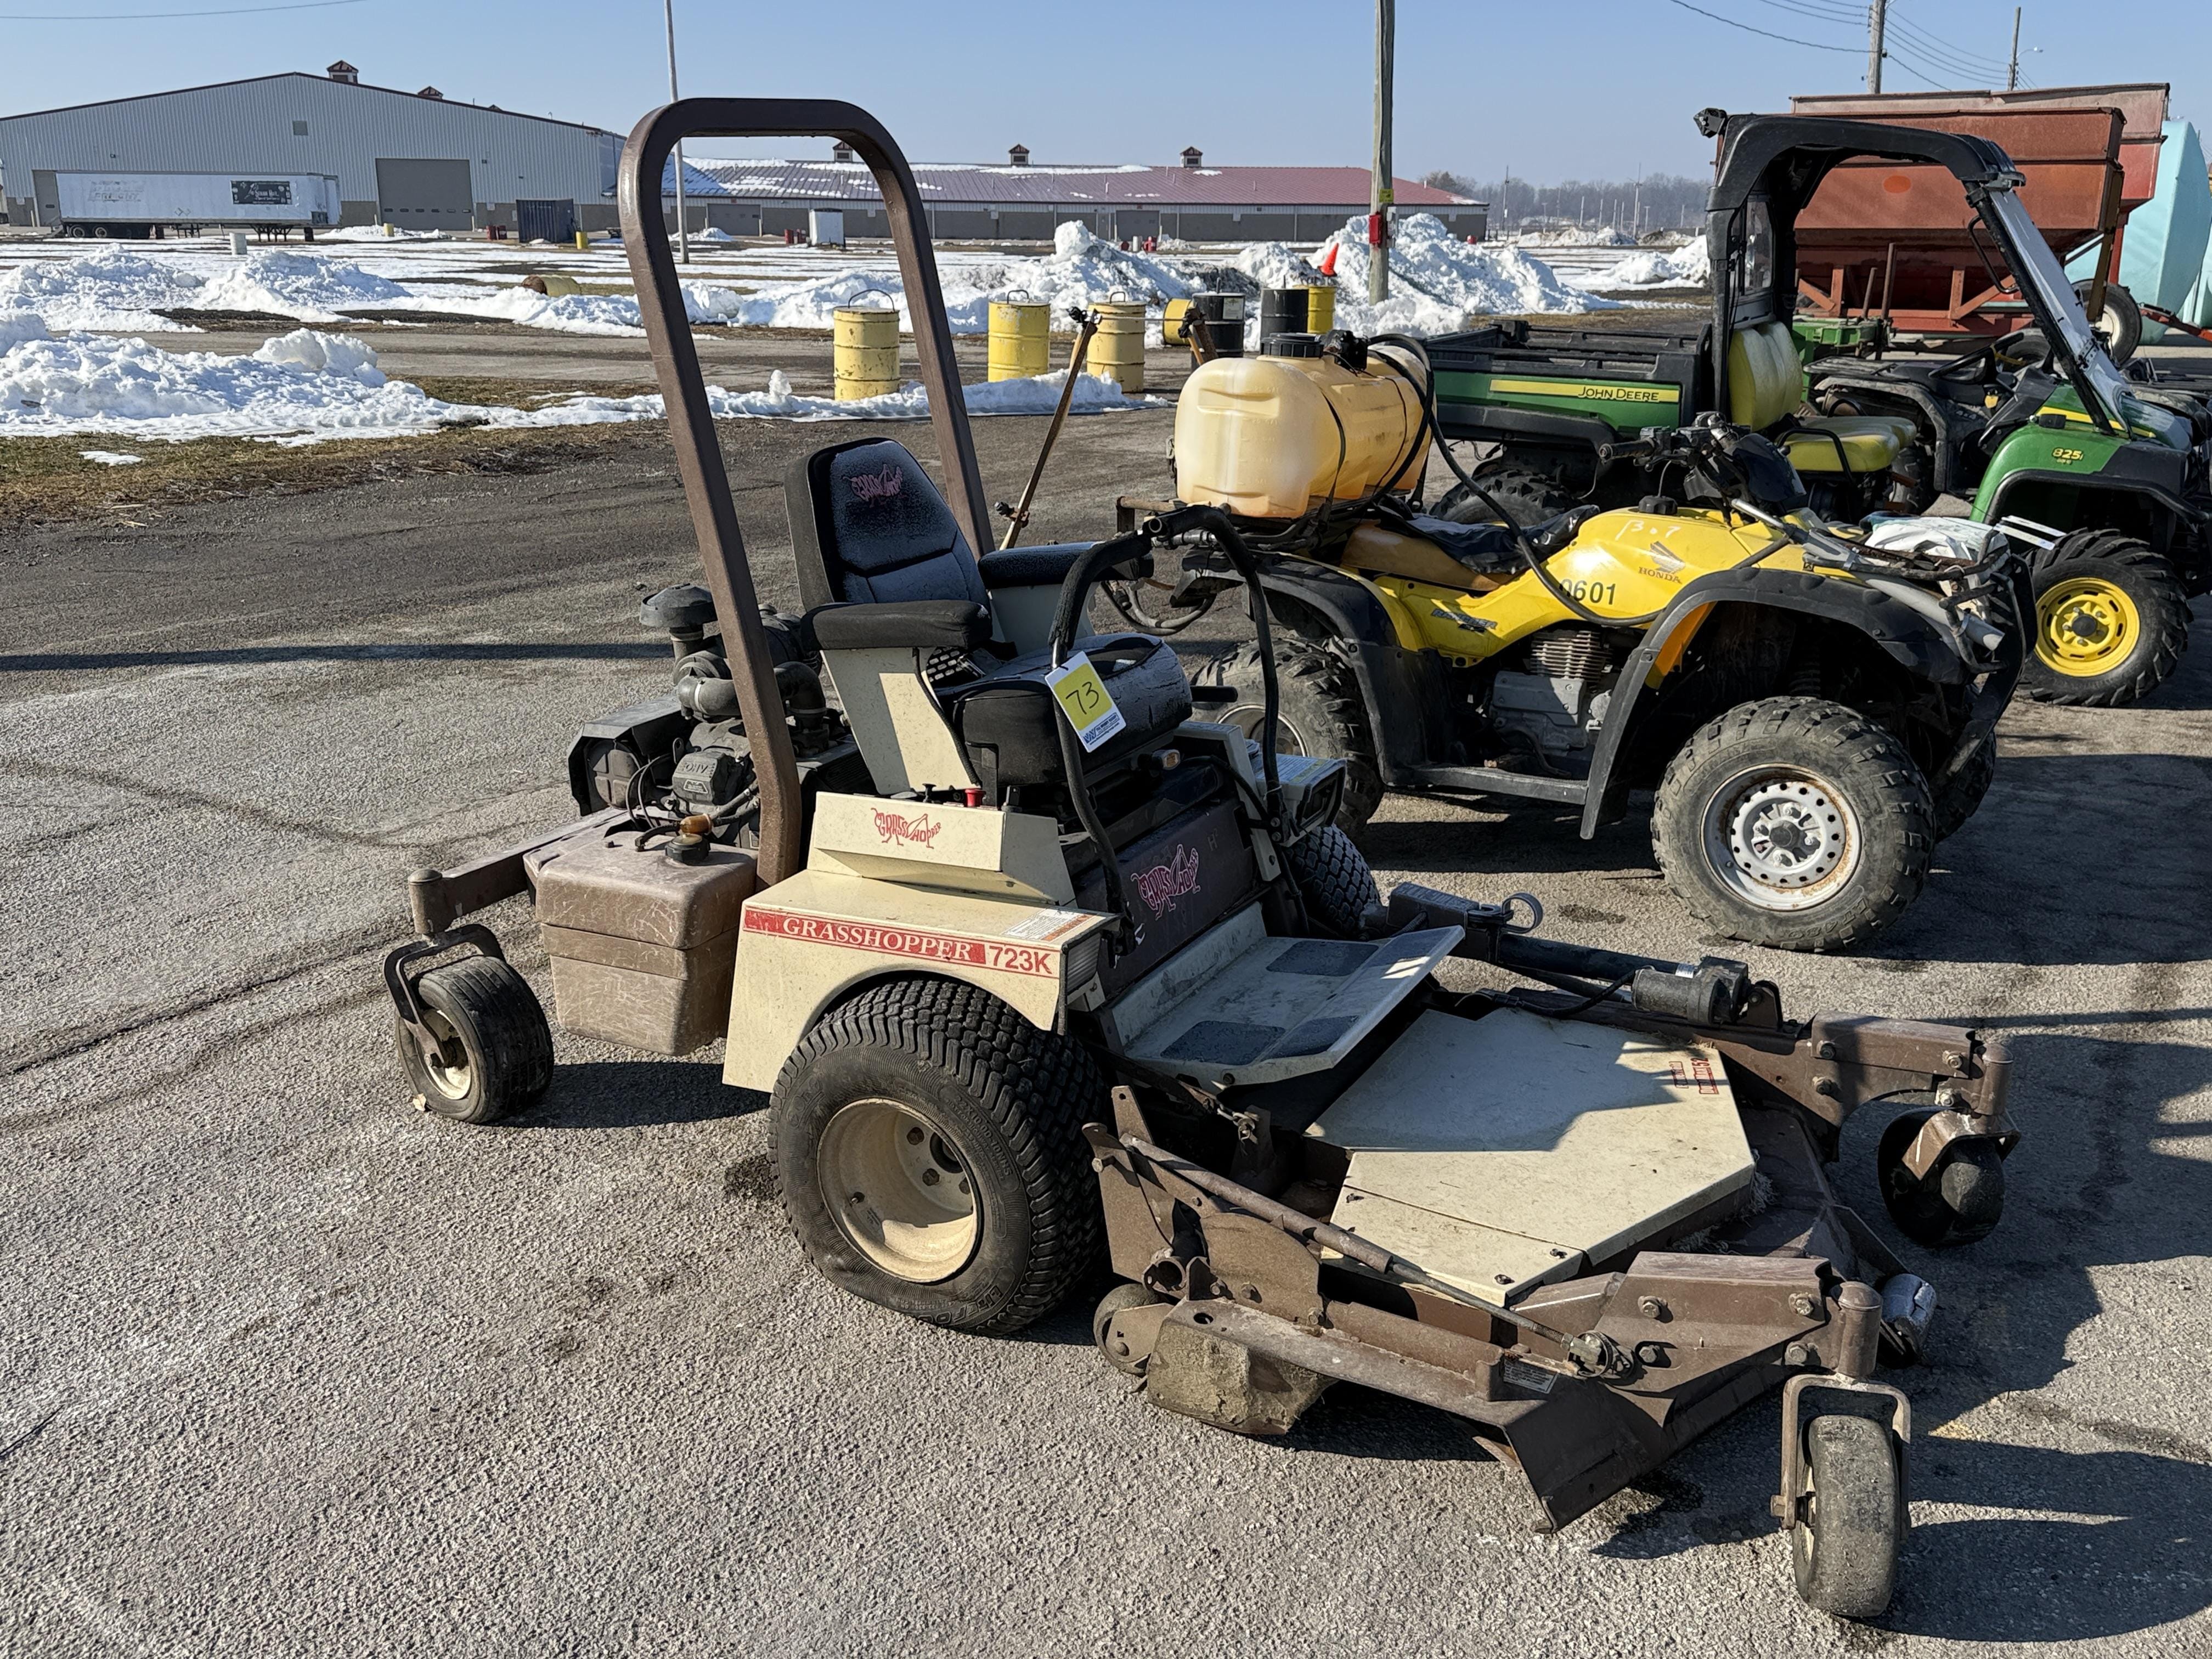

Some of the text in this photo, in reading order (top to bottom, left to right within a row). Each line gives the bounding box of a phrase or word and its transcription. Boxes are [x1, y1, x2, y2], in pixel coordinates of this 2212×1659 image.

[1578, 386, 1660, 401] JOHN DEERE
[1638, 566, 1683, 585] HONDA
[1065, 681, 1099, 715] 73
[873, 812, 942, 846] GRASSHOPPER
[783, 917, 972, 961] GRASSHOPPER
[989, 945, 1053, 975] 723K
